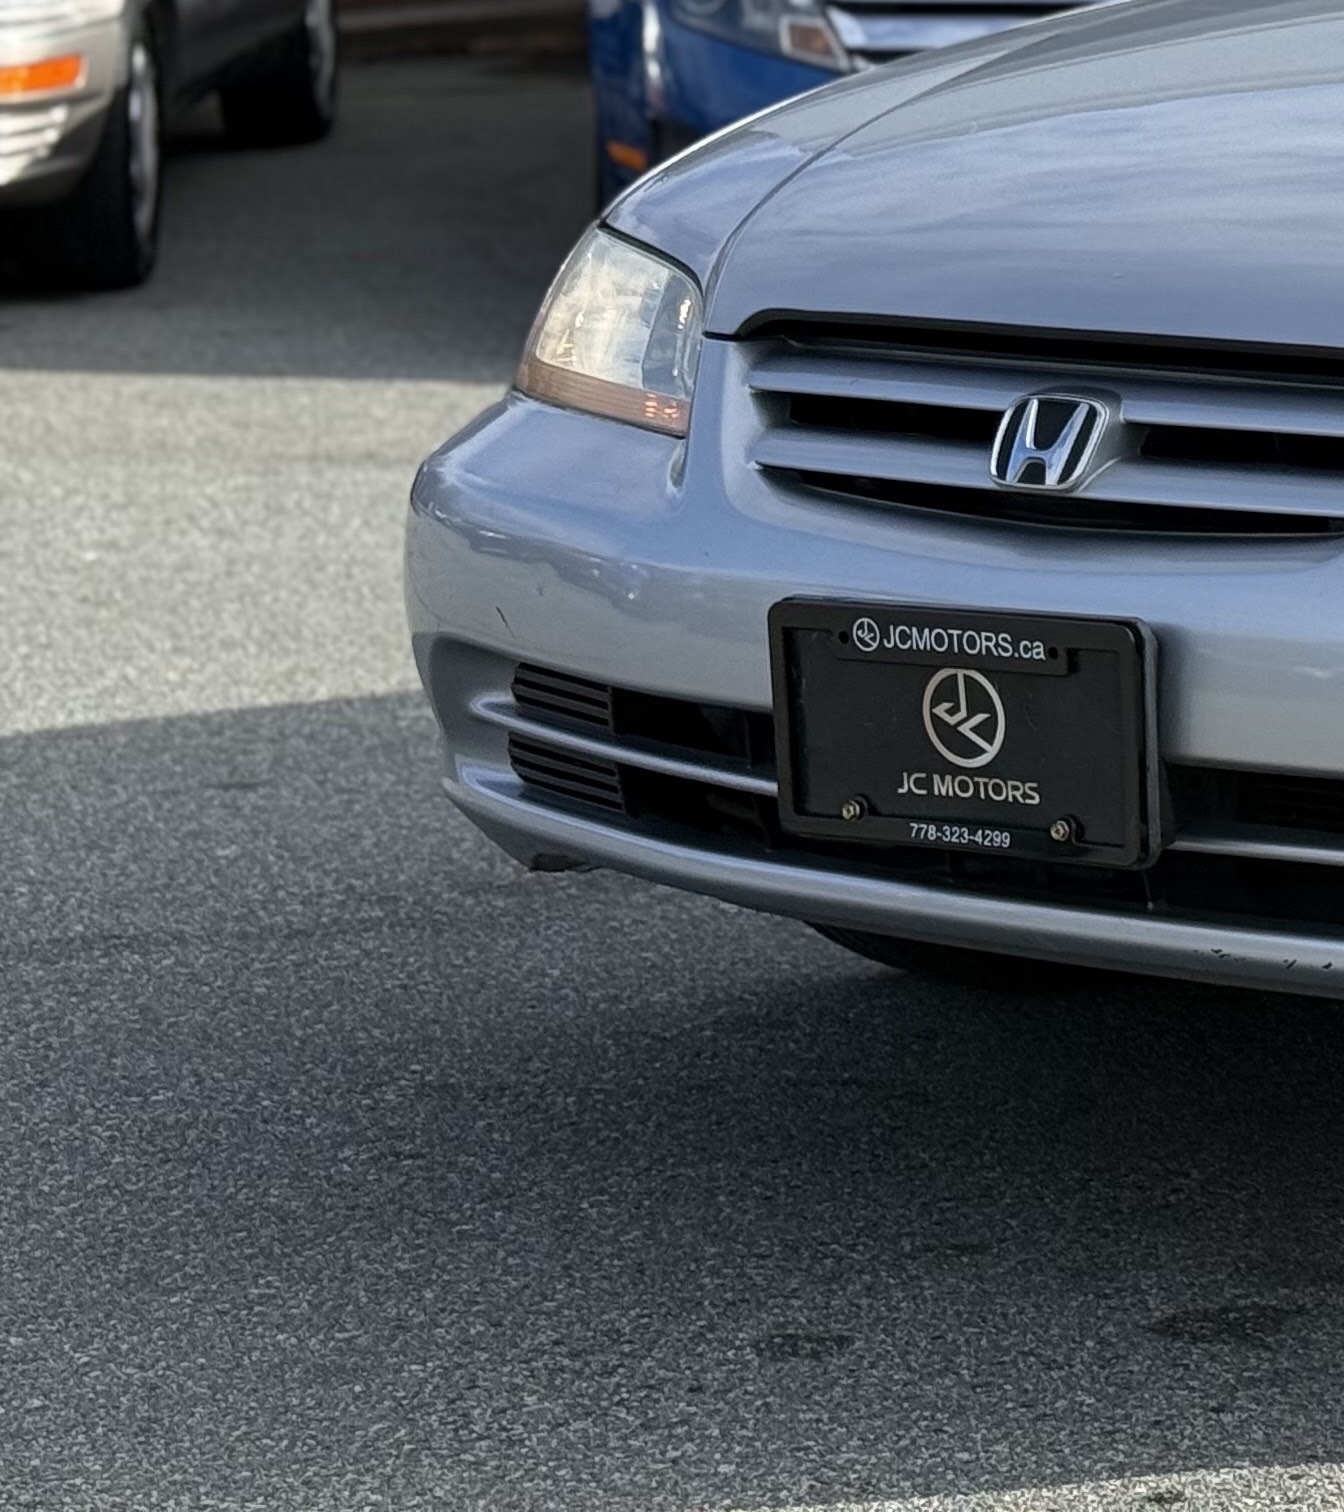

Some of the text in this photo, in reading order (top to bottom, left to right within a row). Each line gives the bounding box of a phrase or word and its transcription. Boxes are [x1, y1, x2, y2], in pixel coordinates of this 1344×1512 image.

[883, 624, 1046, 660] JCMOTORS.ca
[896, 772, 1041, 806] JC MOTORS
[909, 823, 1011, 849] 778-323-4299
